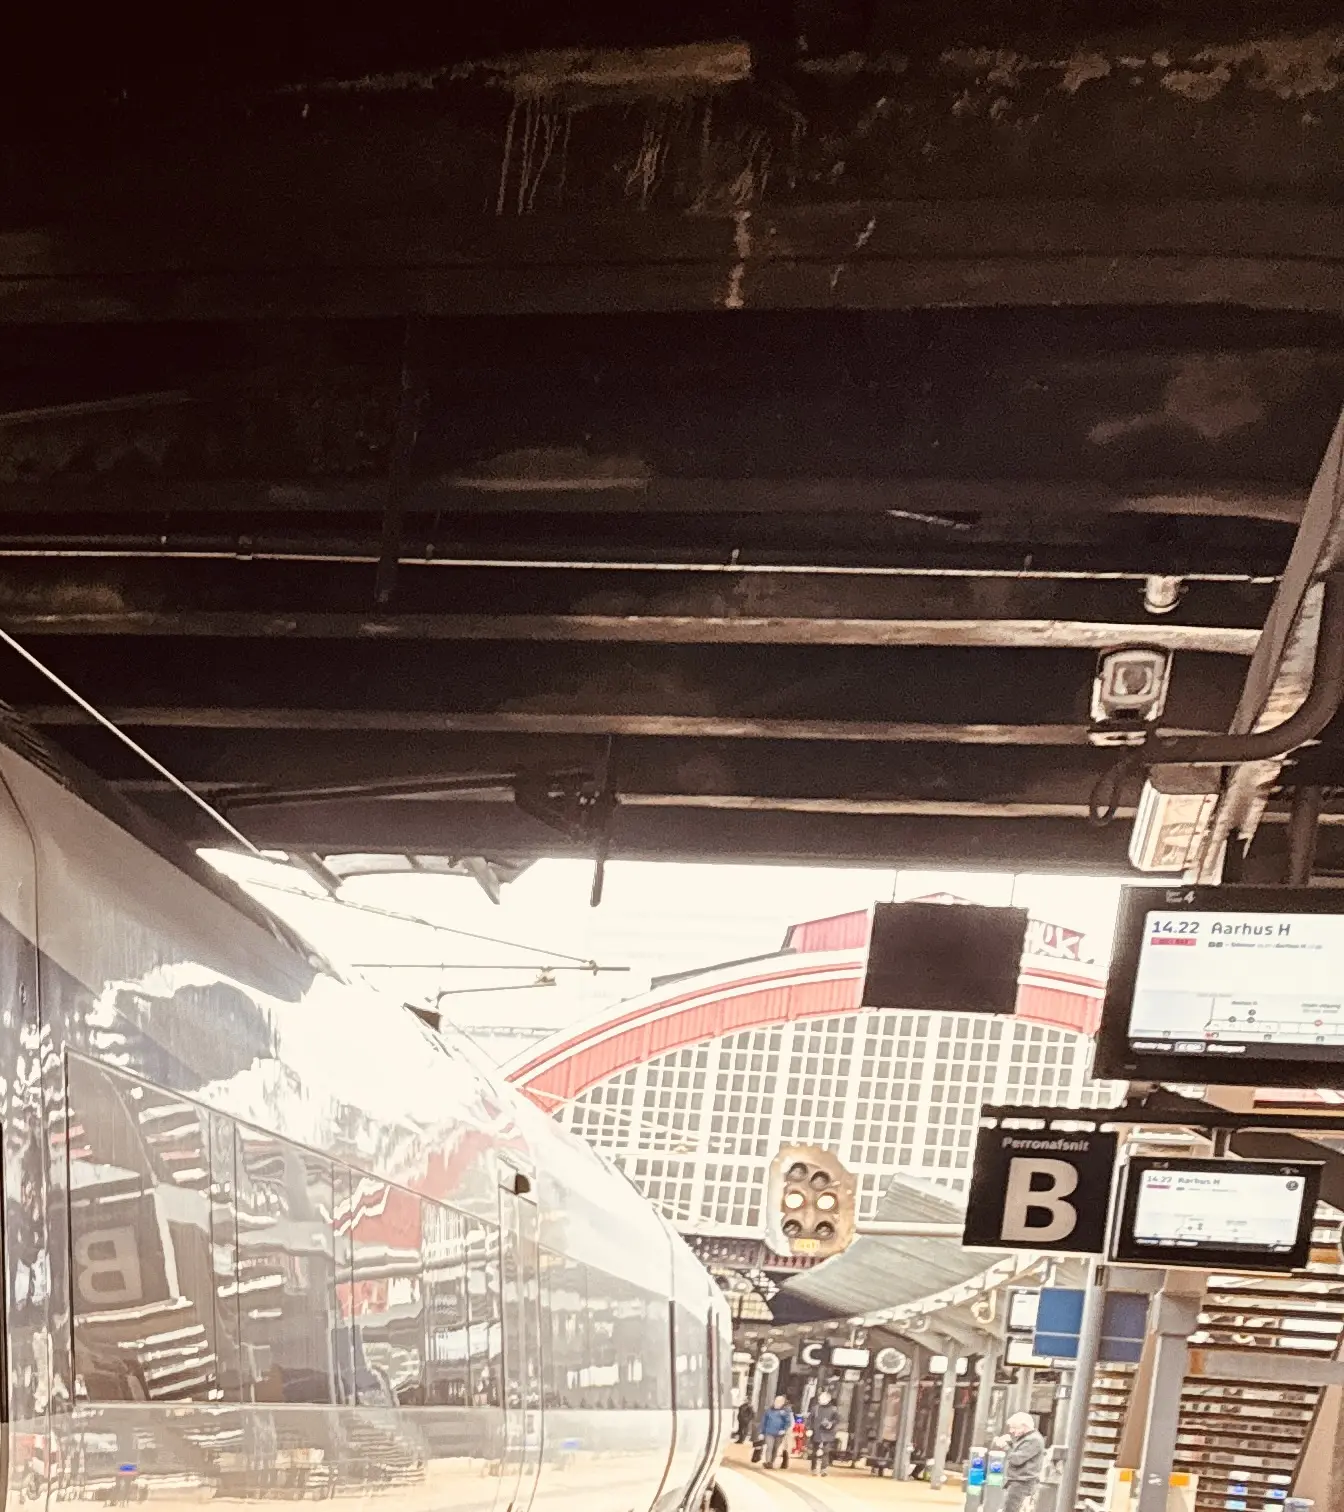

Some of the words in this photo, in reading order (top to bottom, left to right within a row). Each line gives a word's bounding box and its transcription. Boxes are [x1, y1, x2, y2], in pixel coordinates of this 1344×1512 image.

[1152, 921, 1200, 934] 14.22
[1211, 922, 1273, 936] Aarhus
[1278, 923, 1291, 936] H
[1002, 1137, 1090, 1151] Perronafsnit
[1000, 1157, 1078, 1242] B
[802, 1343, 823, 1366] C
